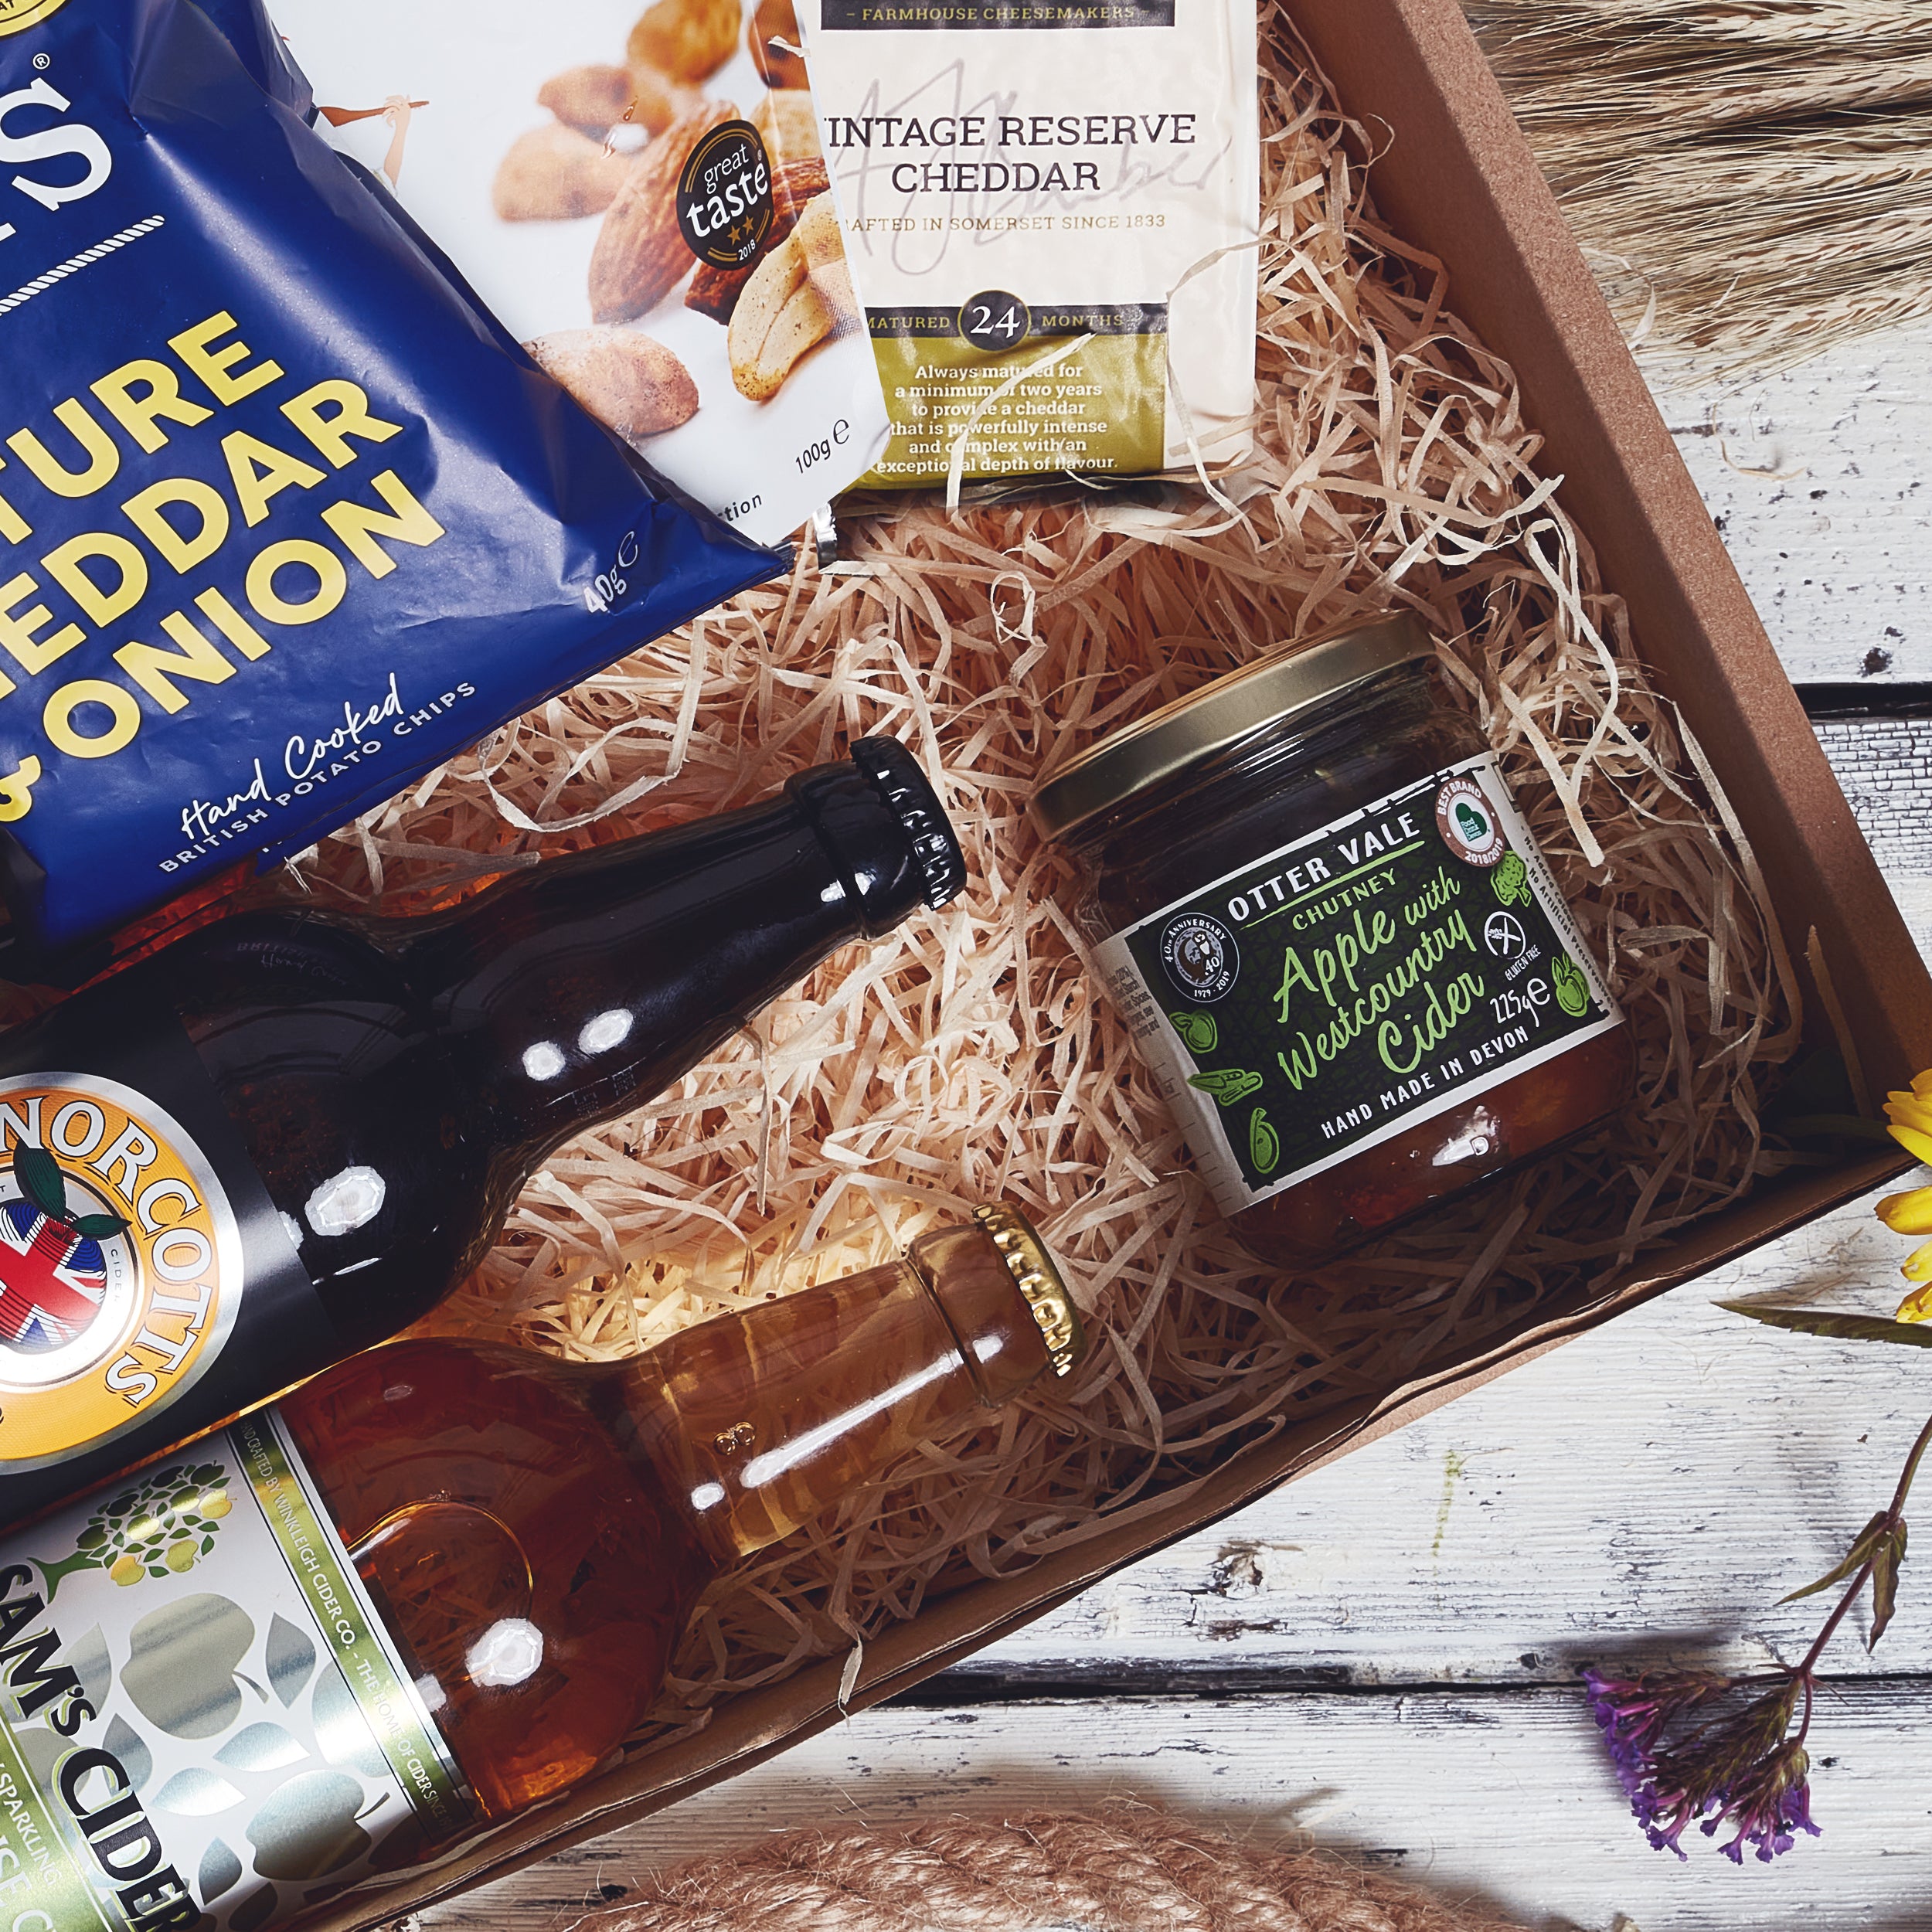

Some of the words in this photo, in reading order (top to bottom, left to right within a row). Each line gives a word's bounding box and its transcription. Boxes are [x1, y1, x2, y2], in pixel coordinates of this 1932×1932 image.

[862, 8, 978, 21] FARMHOUSE
[983, 5, 1134, 20] CHEESEMAKERS
[824, 117, 985, 148] INTAGE
[998, 114, 1196, 146] RESERVE
[0, 77, 112, 240] S
[704, 143, 749, 194] great
[892, 163, 1100, 192] CHEDDAR
[686, 163, 767, 237] taste
[846, 217, 916, 231] AFTED
[923, 217, 942, 230] IN
[950, 216, 1056, 230] SOMERSET
[1062, 216, 1119, 230] SINCE
[1125, 214, 1165, 228] 1833
[738, 239, 756, 261] 2018
[867, 317, 951, 329] MATURED
[970, 305, 1020, 338] 24
[1042, 314, 1124, 327] MONTHS
[895, 387, 905, 397] a
[909, 384, 994, 397] minimum
[1020, 385, 1050, 396] two
[1055, 386, 1102, 400] years
[915, 365, 978, 382] Always
[982, 364, 1054, 378] matued
[1059, 364, 1082, 378] for
[891, 423, 923, 435] that
[929, 422, 944, 435] is
[1043, 420, 1107, 434] intense
[912, 403, 927, 416] to
[933, 402, 997, 419] provie
[1001, 405, 1011, 415] a
[1015, 400, 1085, 415] cheddar
[794, 435, 832, 474] 100g
[877, 458, 976, 474] exceptioal
[981, 457, 1029, 474] depth
[1034, 457, 1049, 471] of
[909, 440, 940, 454] and
[945, 439, 1018, 455] cmplex
[1022, 438, 1060, 452] with
[1066, 441, 1087, 451] an
[717, 493, 762, 523] tion
[0, 379, 403, 696] EDDAR
[583, 563, 627, 614] 40g
[43, 468, 446, 759] ONION
[181, 758, 272, 839] Hand
[284, 672, 404, 780] Cooked
[158, 808, 269, 872] BRITISH
[275, 740, 383, 806] POTATO
[393, 682, 476, 736] CHIPS
[1437, 787, 1452, 815] BEST
[1449, 781, 1481, 798] BRAND
[1228, 857, 1332, 921] OTTER
[1338, 812, 1420, 865] VALE
[1464, 838, 1503, 864] 2018/2019
[1525, 835, 1534, 851] No
[1534, 855, 1554, 889] Added
[1292, 868, 1396, 930] CHUTNEY
[1529, 867, 1539, 883] No
[1539, 886, 1571, 935] Artificial
[1168, 919, 1226, 940] ANNIVERSARY
[1273, 909, 1396, 1023] Apple
[1404, 866, 1460, 925] with
[1505, 955, 1529, 981] GLUTEN
[1526, 944, 1542, 965] FREE
[1194, 989, 1211, 998] 1979
[1216, 971, 1231, 991] 2019
[1277, 909, 1477, 1090] Westcountry
[1377, 972, 1485, 1073] Cider
[1490, 989, 1540, 1028] 225g
[1321, 1104, 1372, 1138] HAND
[1380, 1073, 1435, 1110] MADE
[1440, 1058, 1464, 1080] IN
[1470, 1026, 1529, 1066] DEVON
[0, 1097, 213, 1406] NORCOTTS
[247, 1434, 272, 1477] CRAFTED
[265, 1477, 282, 1494] BY
[274, 1492, 320, 1573] WINKLEIGH
[312, 1573, 342, 1621] CIDER
[335, 1619, 355, 1649] CO.
[356, 1658, 379, 1692] THE
[373, 1692, 404, 1739] HOME
[397, 1740, 416, 1757] OF
[406, 1758, 432, 1794] CIDER
[423, 1790, 447, 1818] SINCE
[56, 1747, 202, 1932] CIDER
